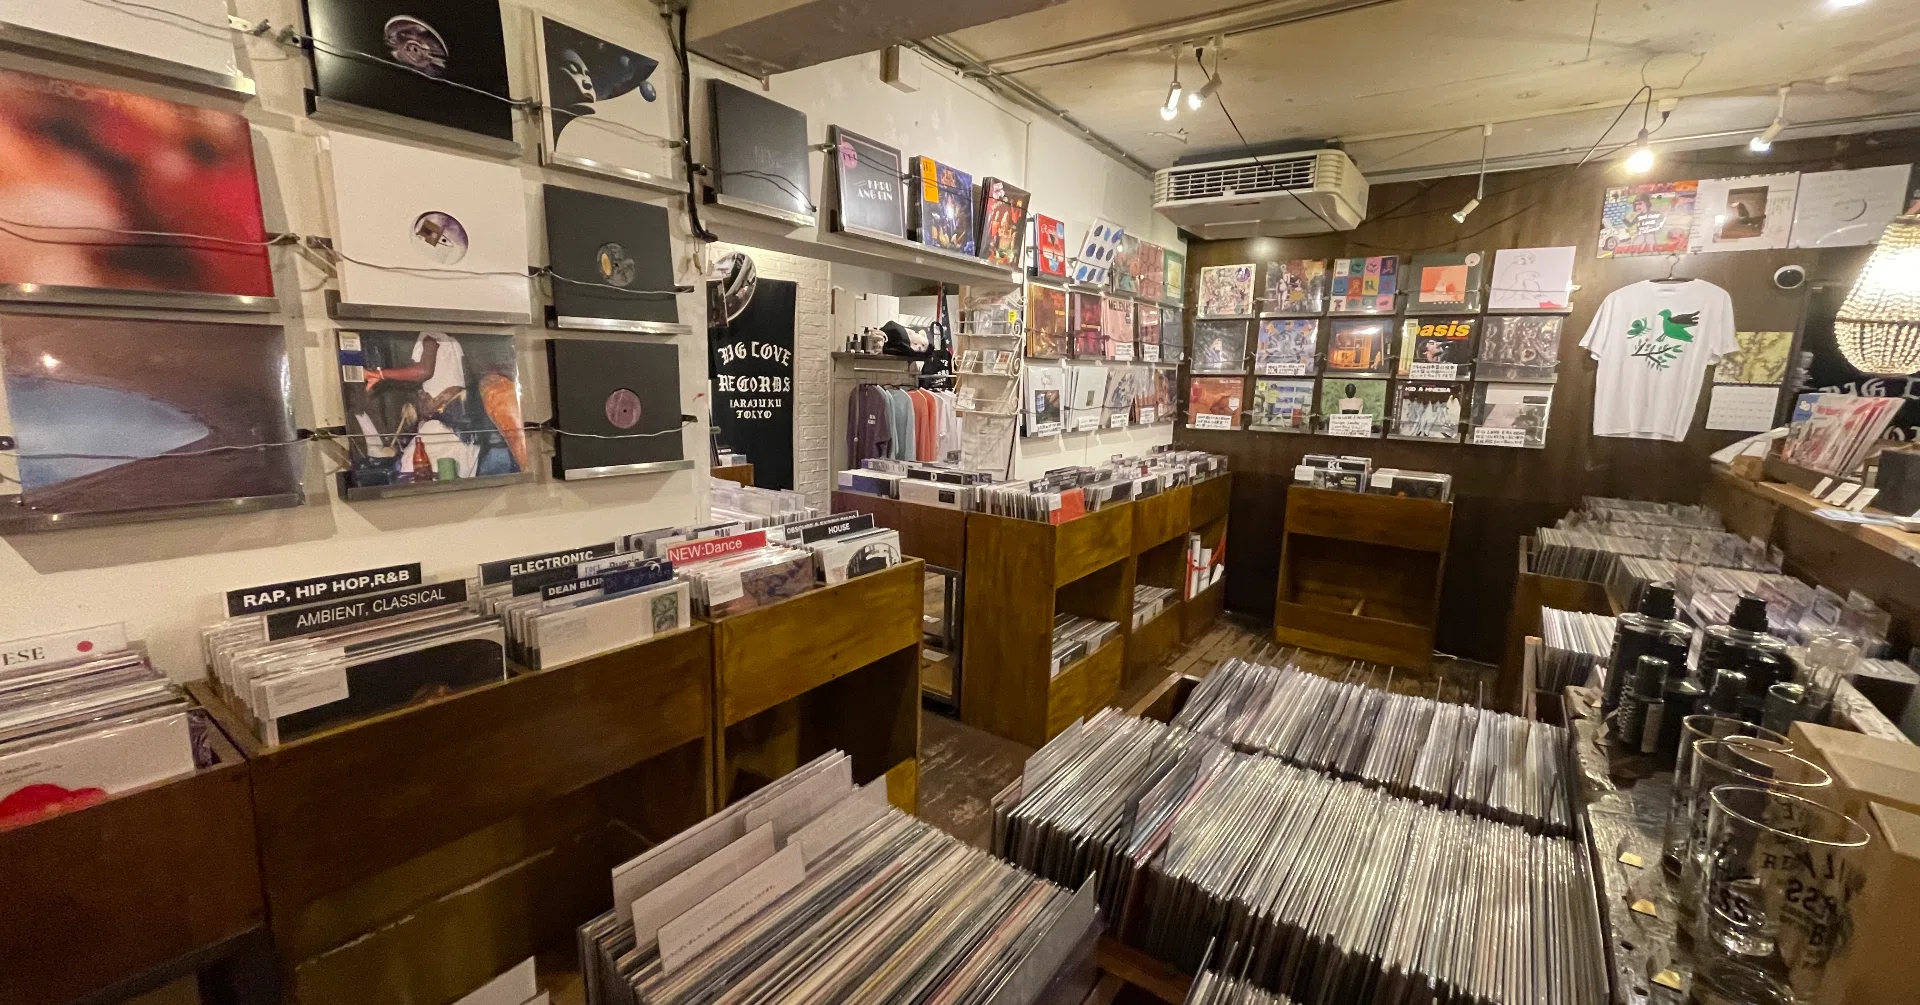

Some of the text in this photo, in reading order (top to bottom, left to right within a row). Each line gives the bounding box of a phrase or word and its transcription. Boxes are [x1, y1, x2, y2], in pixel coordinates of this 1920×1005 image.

[751, 341, 792, 367] LOVE
[717, 374, 791, 393] RECORDS
[735, 410, 772, 419] TOKYO
[828, 522, 851, 535] HOUSE
[668, 539, 743, 562] NEW:Dance
[509, 550, 594, 576] ELECTRONIC
[243, 569, 410, 608] RAP, HIP HOP,R&B
[547, 576, 604, 596] DEAN BLUN
[297, 588, 446, 629] AMBIENT, CLASSICAL
